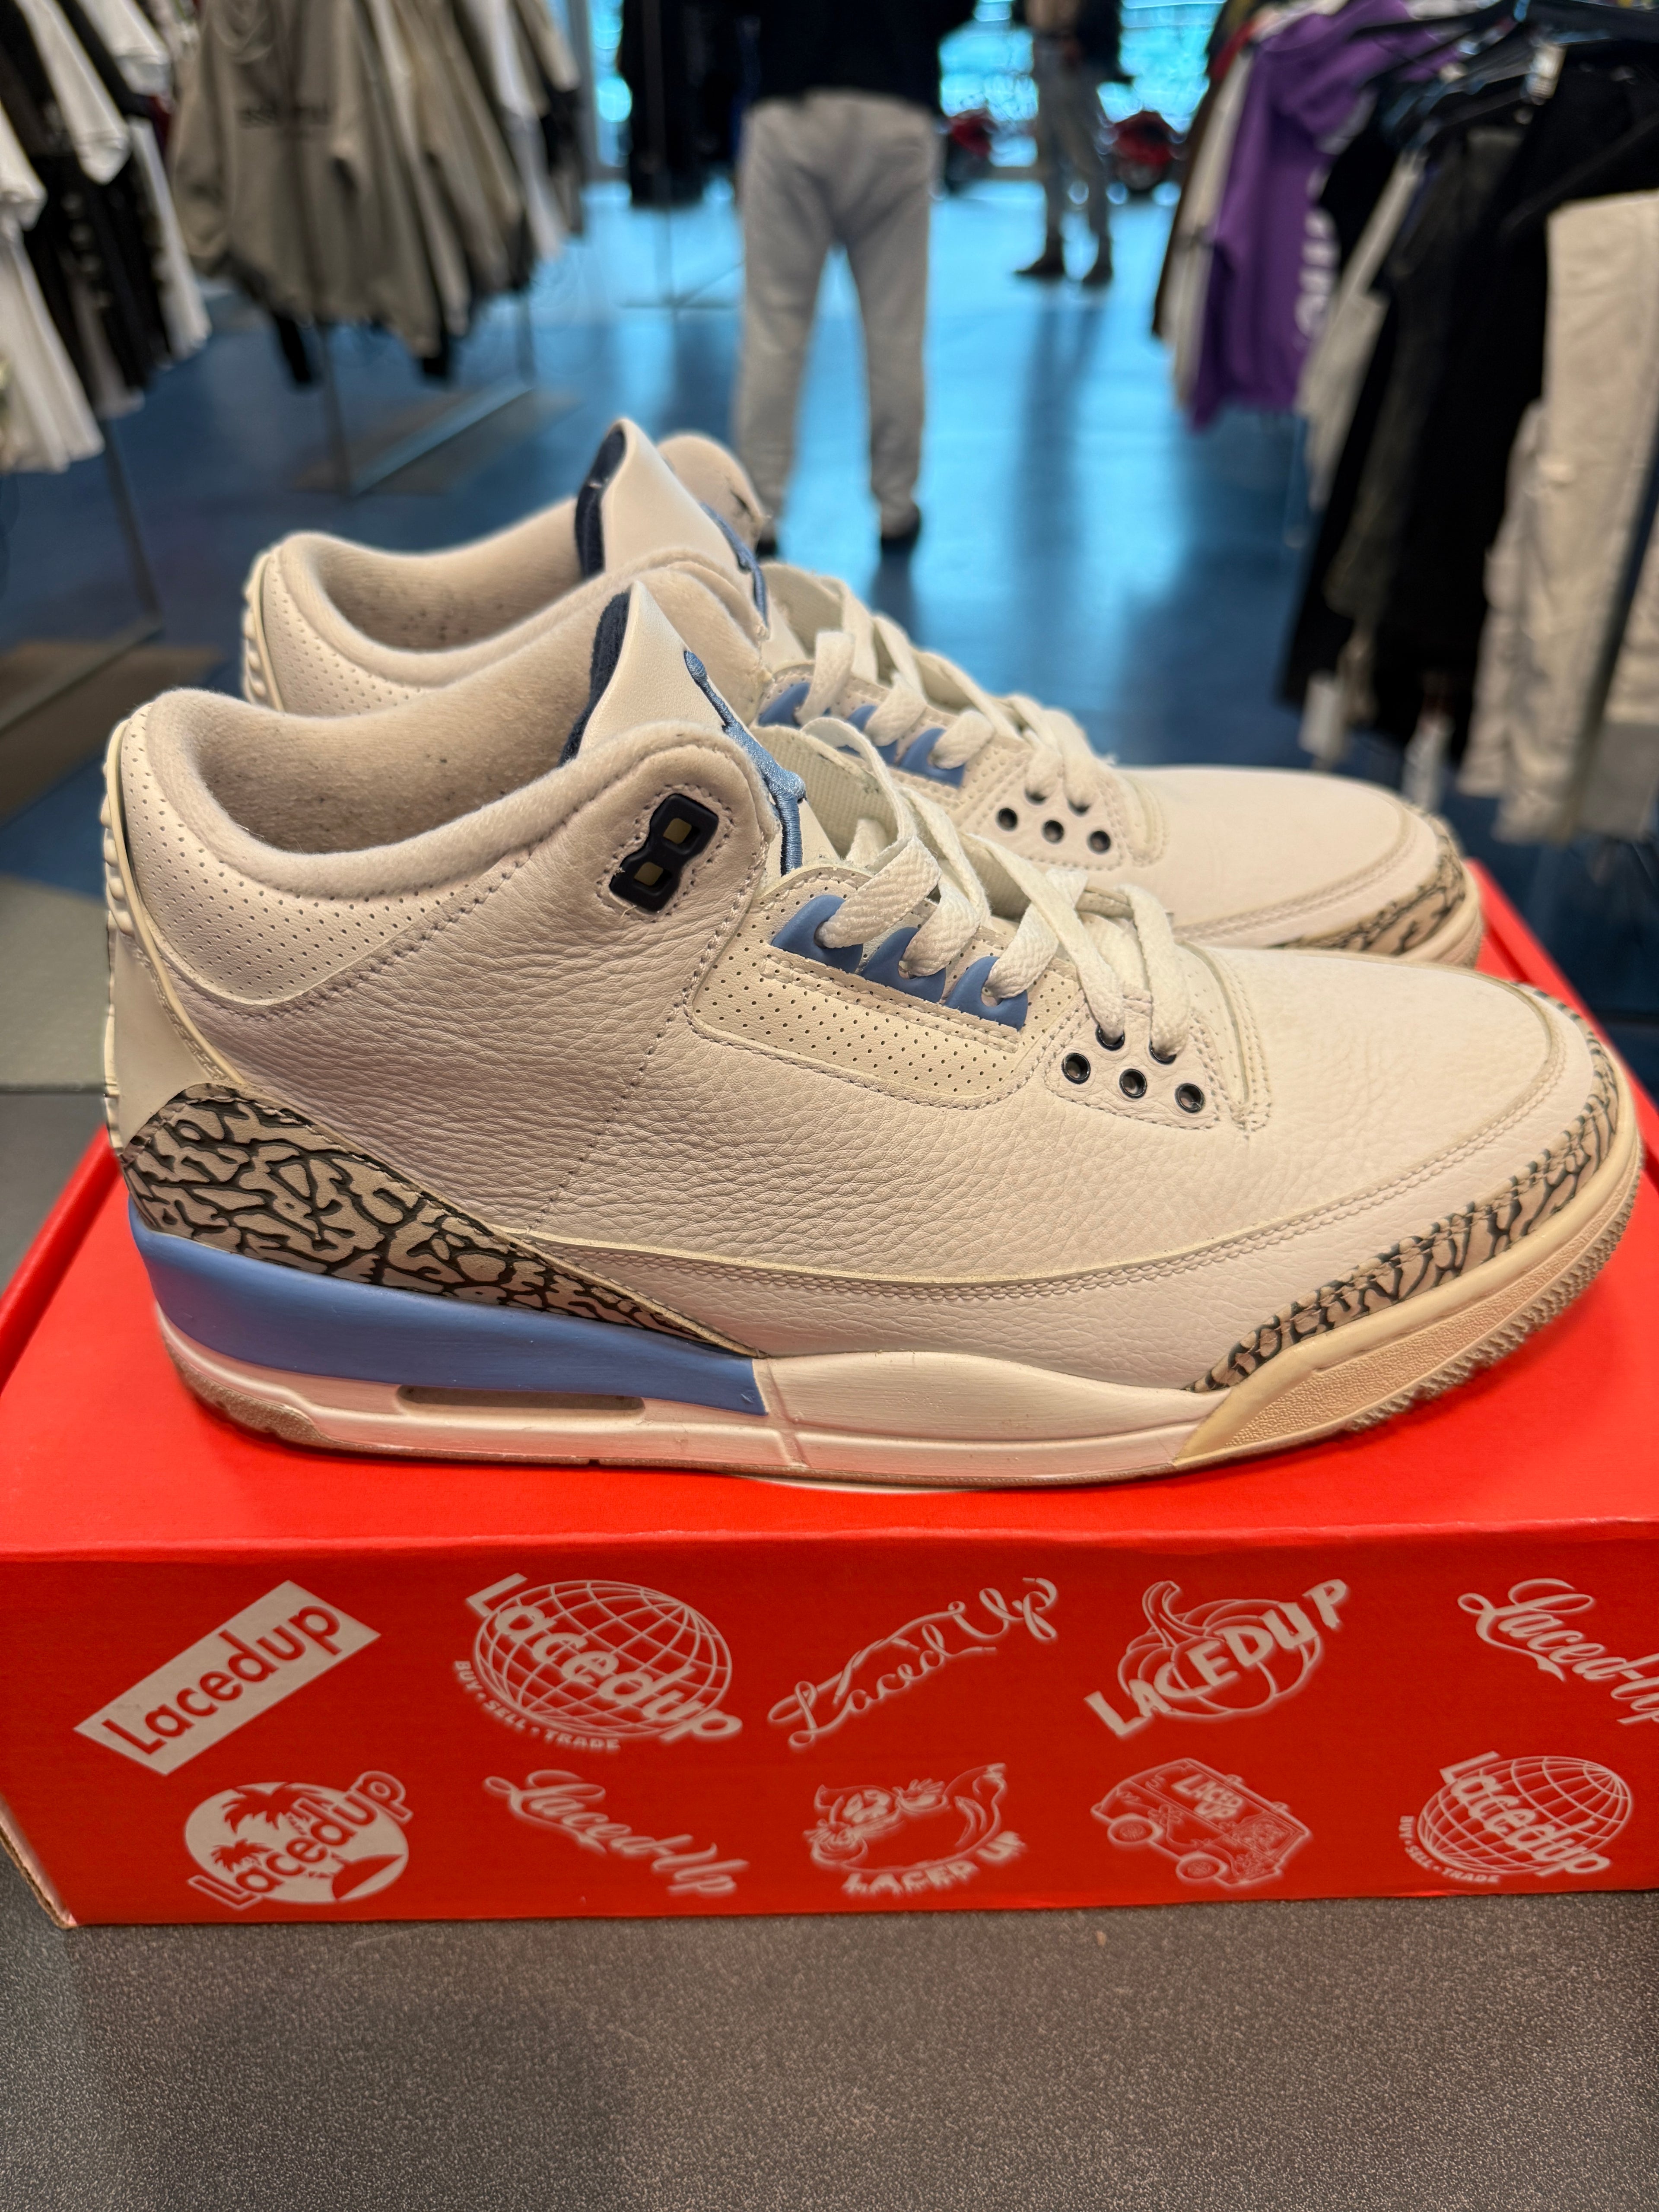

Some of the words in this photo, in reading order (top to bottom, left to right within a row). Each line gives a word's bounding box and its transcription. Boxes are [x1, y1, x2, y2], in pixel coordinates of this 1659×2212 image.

[101, 1605, 343, 1755] Lacedup
[454, 1660, 483, 1691] BUY
[483, 1699, 527, 1732] SELL
[544, 1729, 621, 1753] TRADE
[465, 1573, 743, 1744] Lacedup
